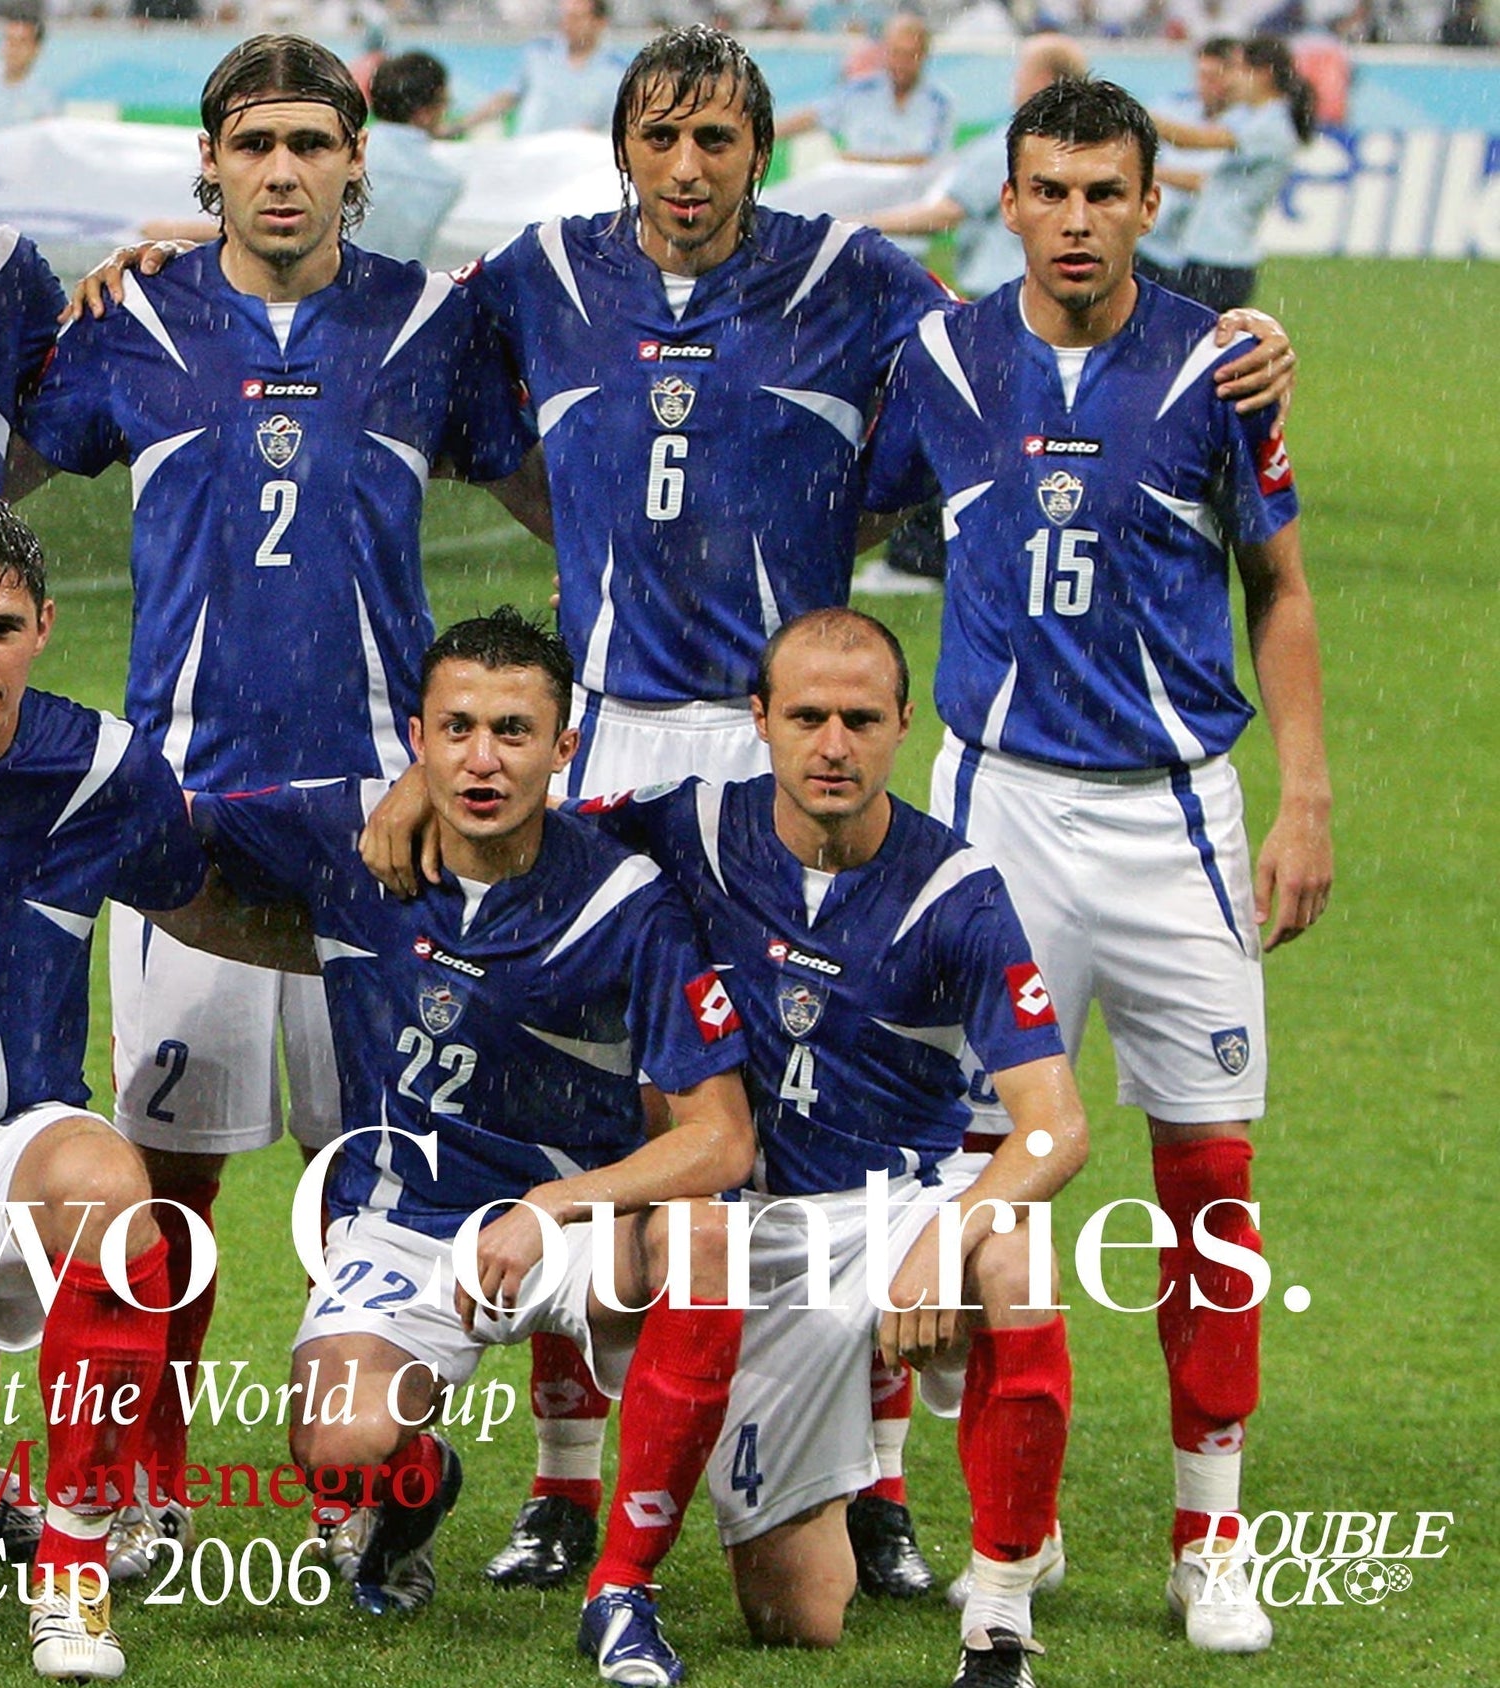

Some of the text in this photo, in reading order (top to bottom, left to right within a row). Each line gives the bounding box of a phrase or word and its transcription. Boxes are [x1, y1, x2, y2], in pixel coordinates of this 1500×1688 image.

[645, 433, 689, 521] 6
[254, 479, 299, 567] 2
[1024, 528, 1100, 617] 15
[145, 1039, 189, 1124] 2
[396, 1025, 478, 1115] 22
[779, 1043, 819, 1118] 4
[731, 1422, 764, 1508] 4
